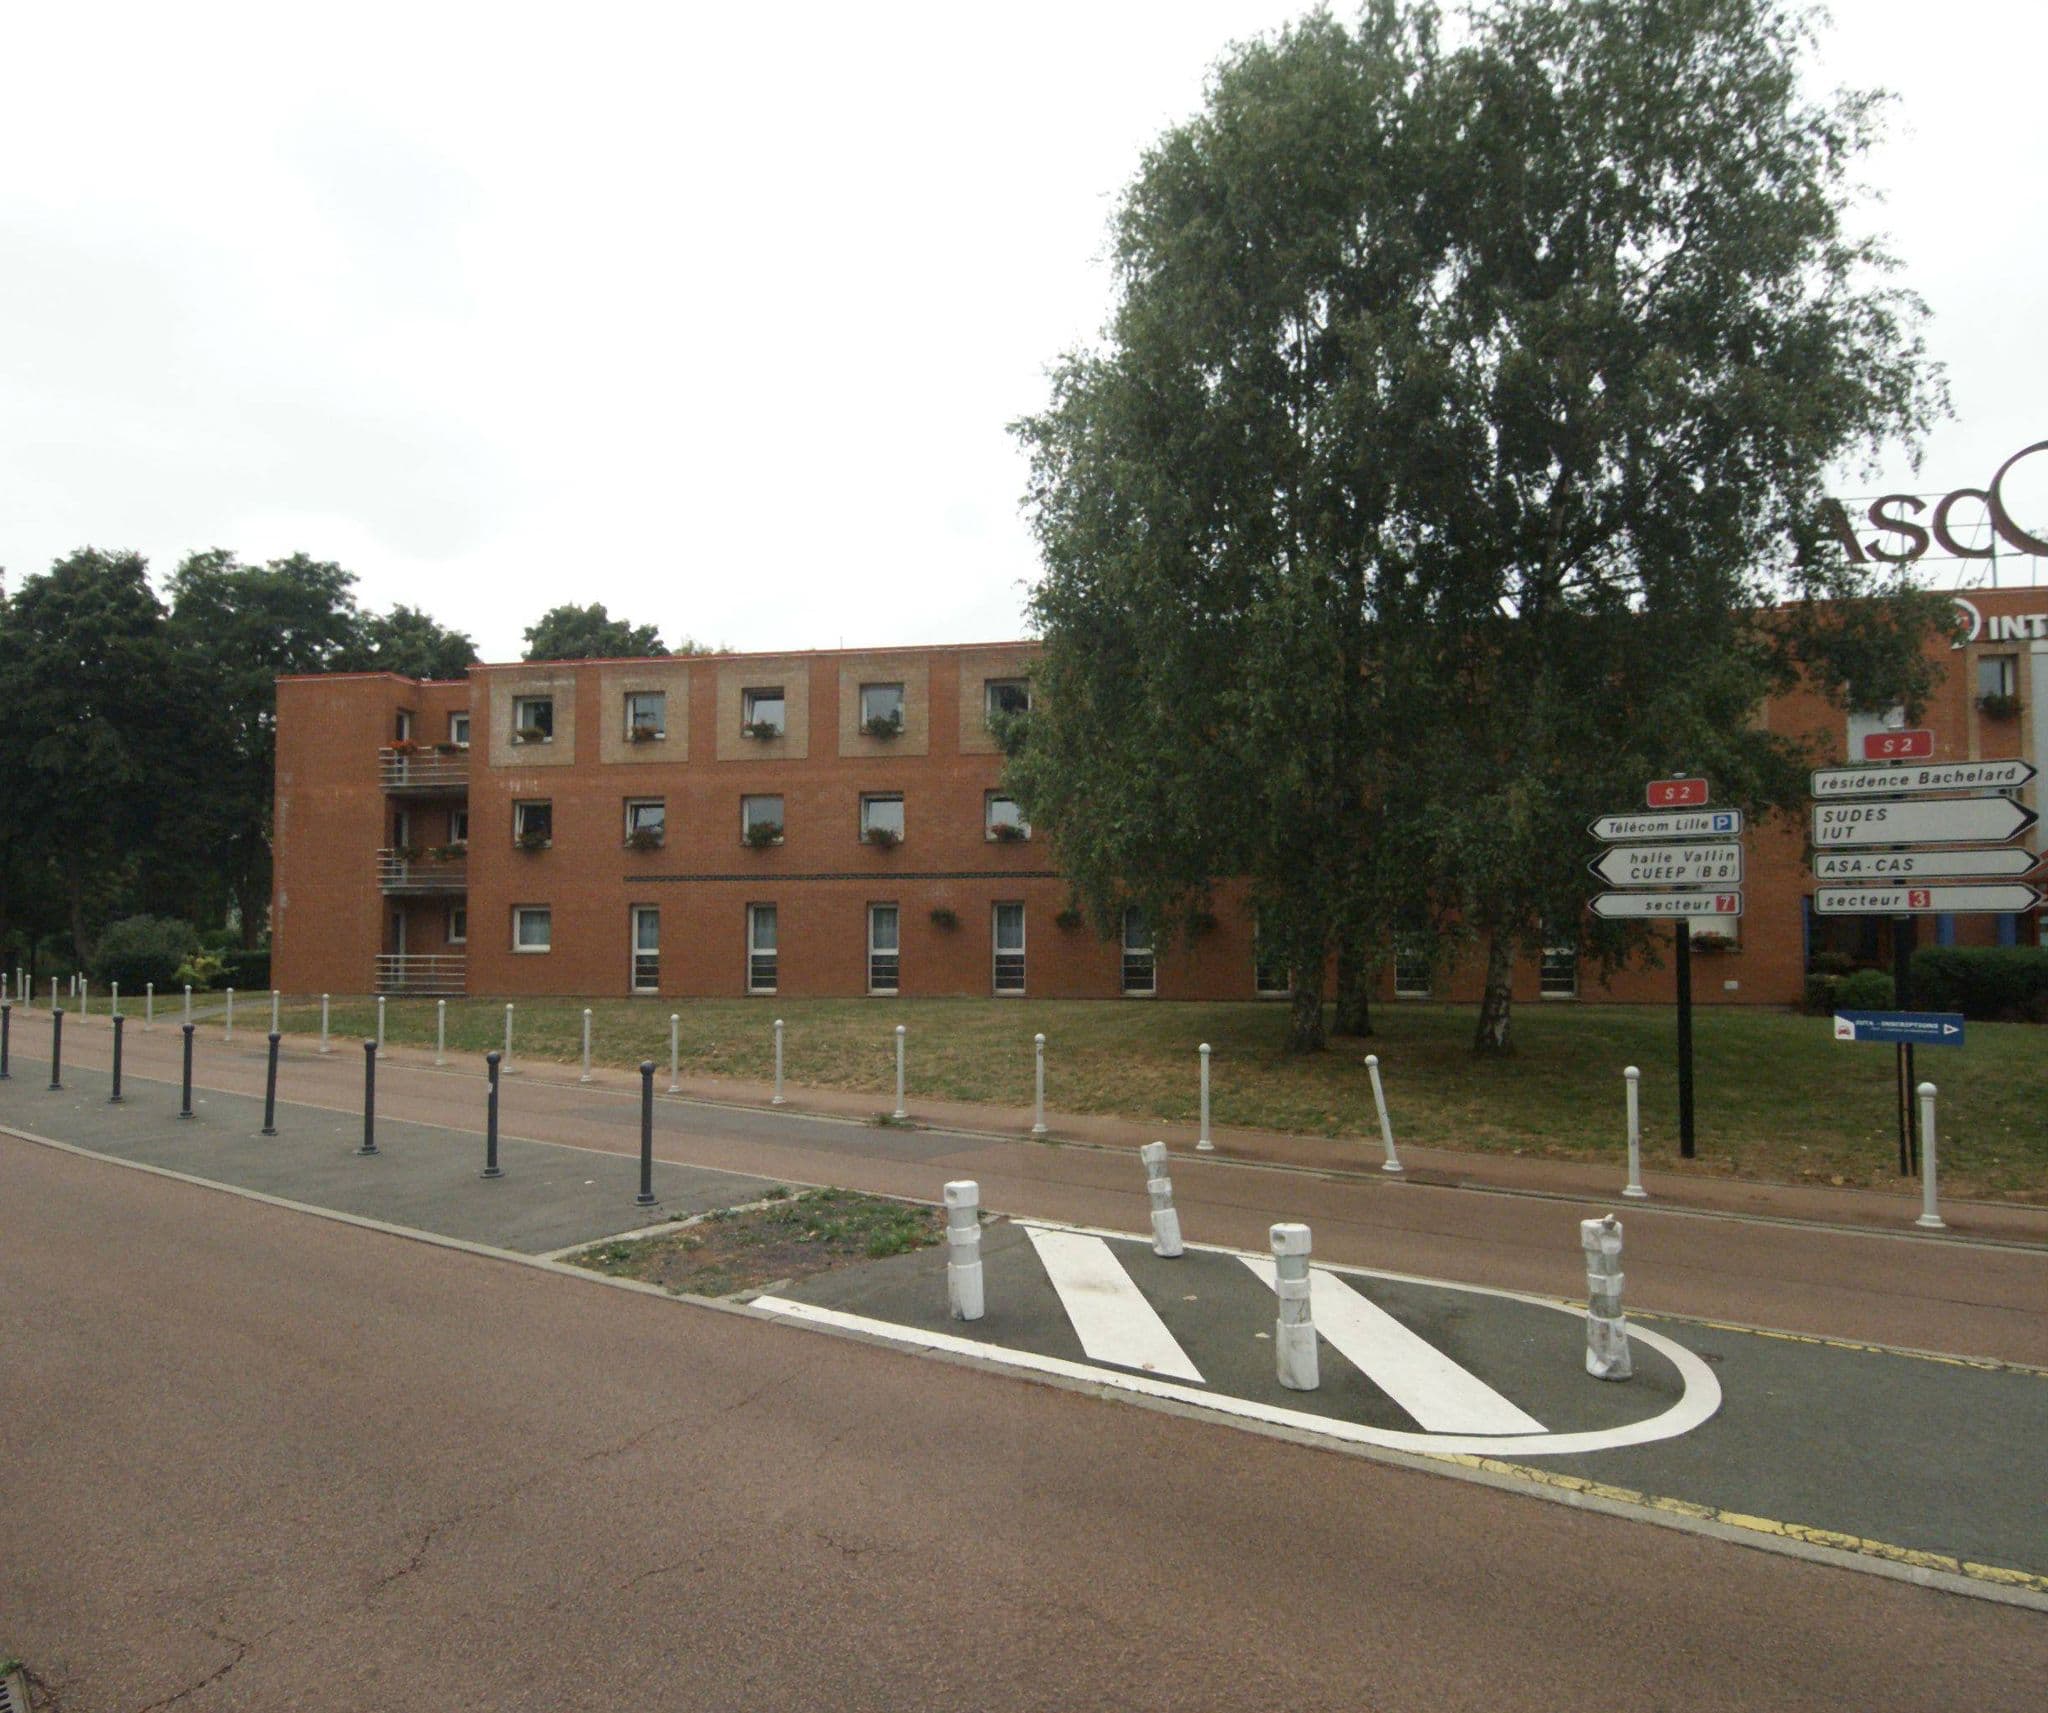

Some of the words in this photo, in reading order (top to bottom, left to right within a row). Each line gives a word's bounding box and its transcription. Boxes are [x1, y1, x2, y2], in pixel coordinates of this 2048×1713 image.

[1883, 739, 1894, 752] S
[1901, 737, 1913, 752] 2
[1821, 775, 1909, 790] résidence
[1918, 767, 2017, 785] Bachelard
[1665, 788, 1674, 800] S
[1680, 786, 1690, 800] 2
[1822, 808, 1888, 823] SUDES
[1609, 821, 1669, 834] Télécom
[1675, 817, 1709, 832] Lille
[1822, 826, 1855, 840] IUT
[1683, 851, 1735, 864] Vallin
[1630, 866, 1686, 880] CUEEP
[1645, 900, 1711, 912] secteur
[1720, 895, 1731, 910] 7
[1825, 894, 1901, 907] secteur
[1914, 891, 1927, 907] 3
